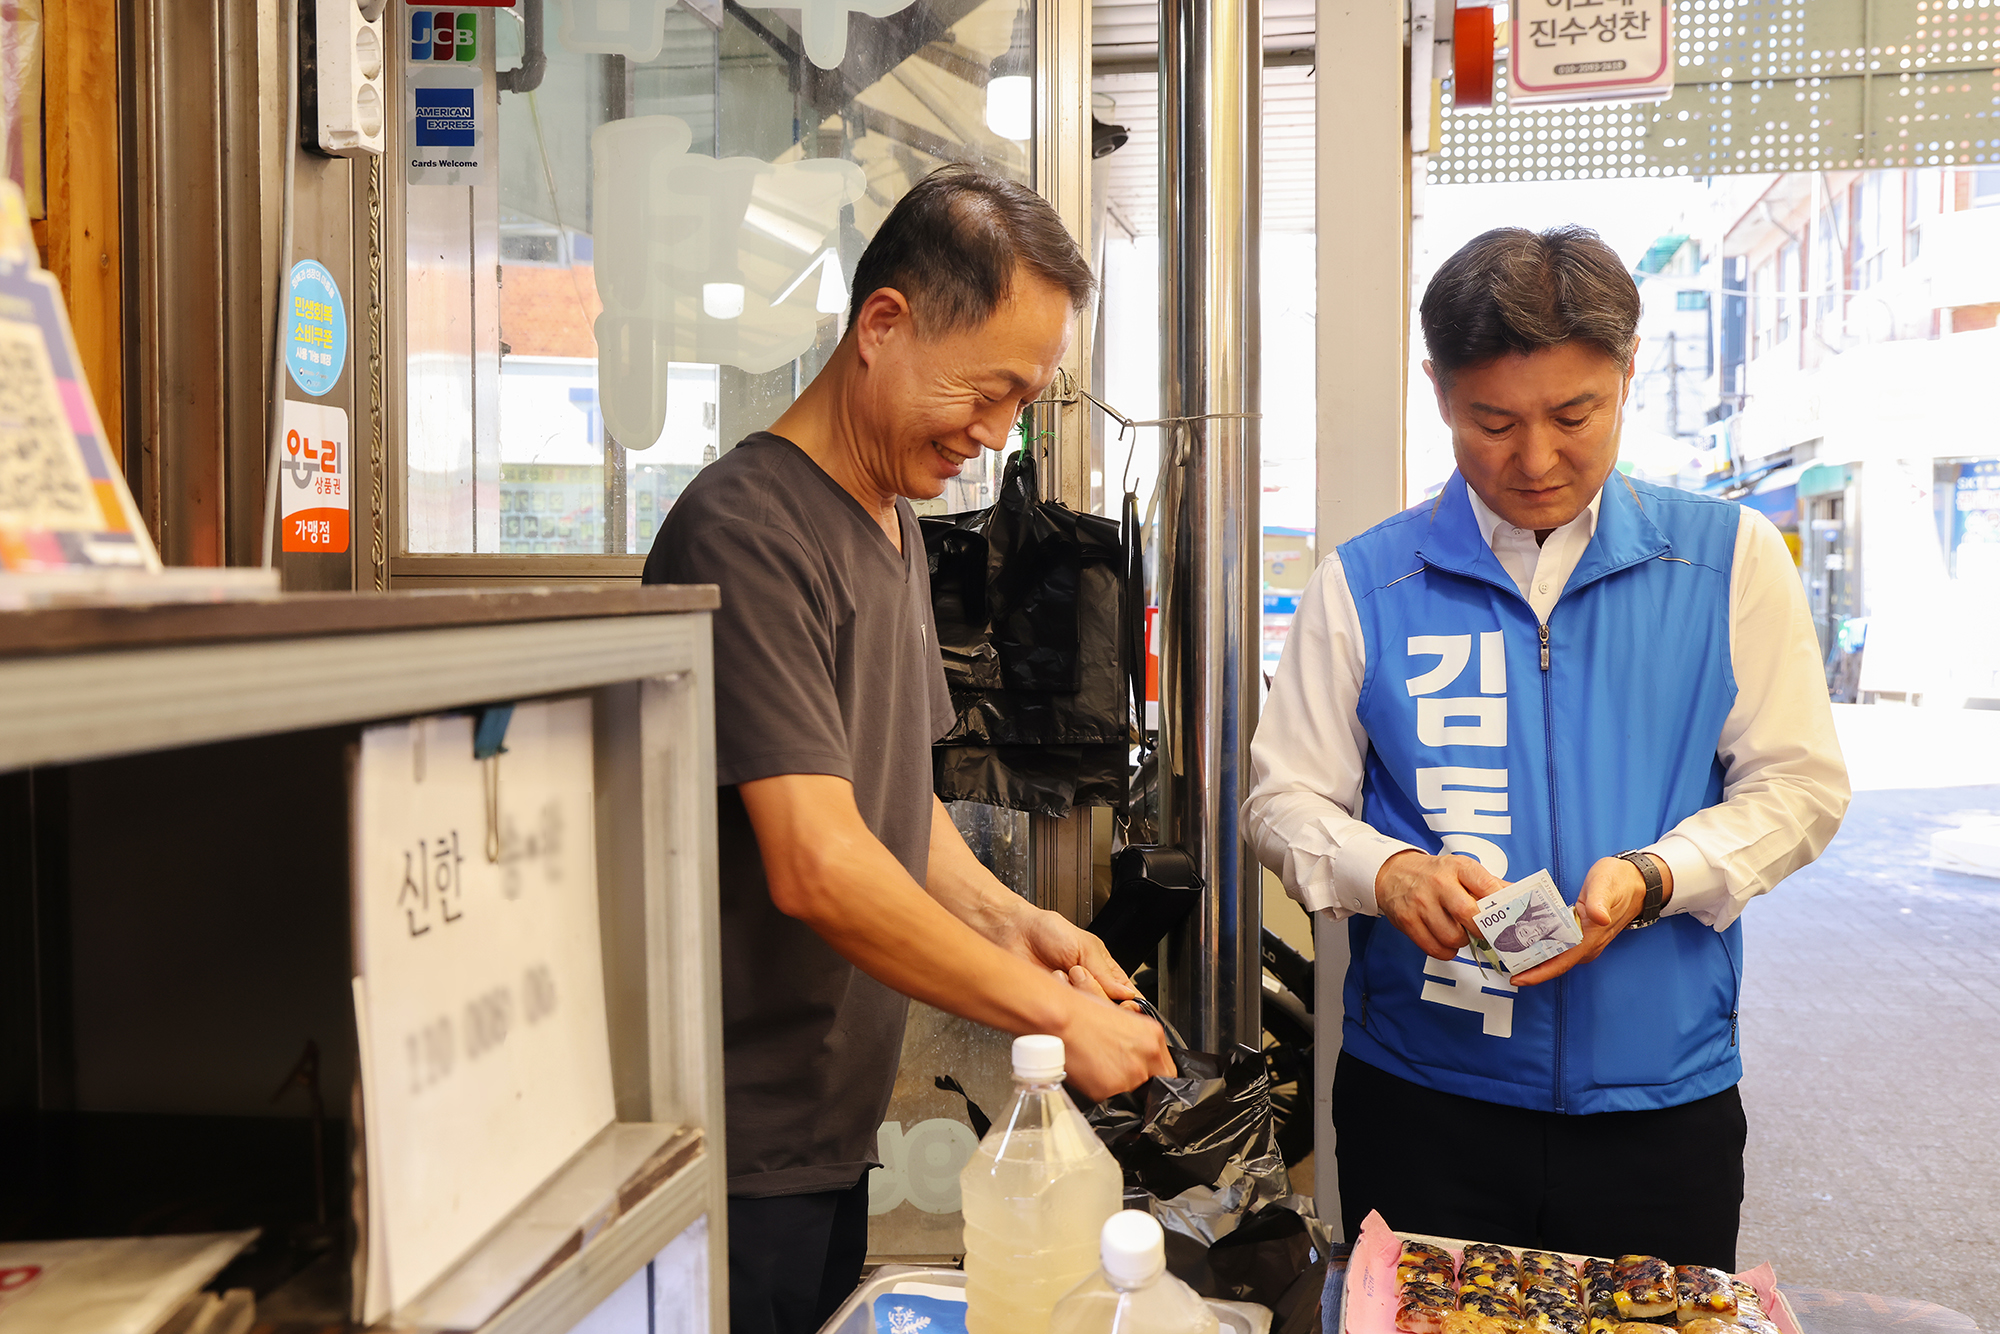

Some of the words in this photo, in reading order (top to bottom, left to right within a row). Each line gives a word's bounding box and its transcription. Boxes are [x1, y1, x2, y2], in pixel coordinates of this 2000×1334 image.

[1529, 10, 1650, 48] 진수성찬
[415, 107, 471, 117] AMERICAN
[427, 120, 475, 130] EXPRESS
[411, 160, 437, 168] Cards
[439, 160, 478, 168] Welcome
[294, 296, 333, 325] 민생회복
[294, 322, 333, 350] 소비쿠폰
[295, 347, 308, 360] 사용
[314, 476, 341, 496] 상품권
[295, 519, 330, 544] 가맹점
[396, 829, 464, 938] 신한
[1480, 909, 1507, 929] 1000
